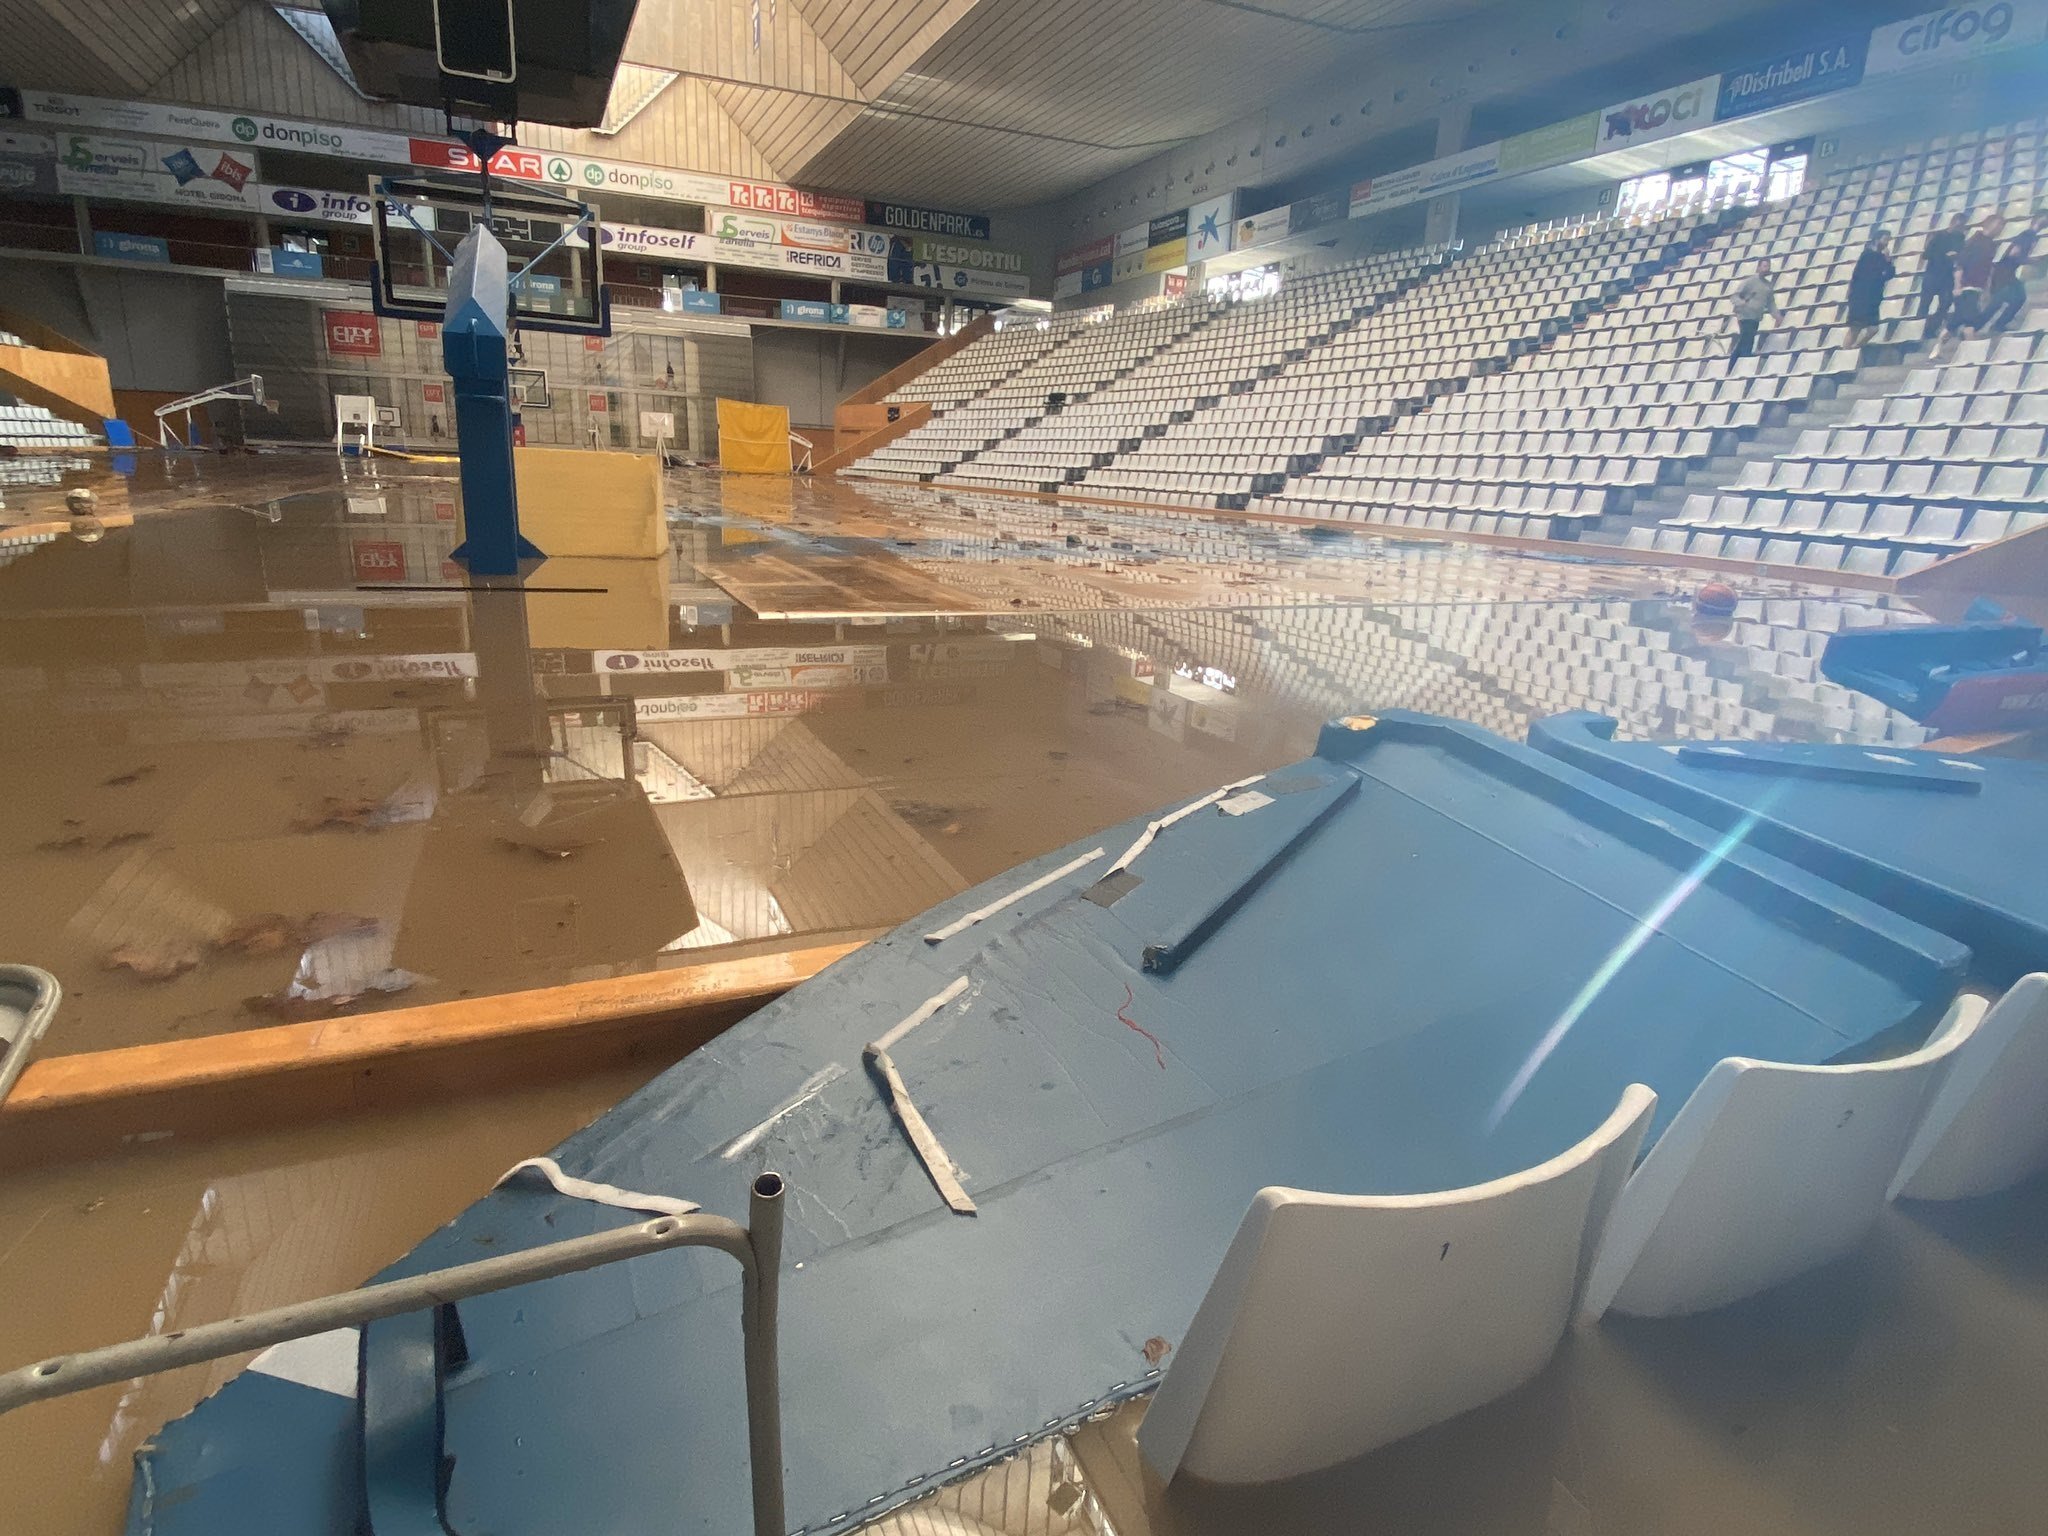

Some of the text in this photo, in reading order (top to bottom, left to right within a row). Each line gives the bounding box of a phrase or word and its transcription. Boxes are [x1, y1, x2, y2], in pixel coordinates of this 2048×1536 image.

[1818, 47, 1850, 77] S.A.
[263, 122, 343, 148] donpiso
[609, 169, 674, 191] donpiso
[321, 210, 368, 221] group
[617, 227, 695, 250] infoself
[794, 223, 823, 238] Estanys
[118, 240, 160, 255] girona
[617, 242, 648, 253] group
[870, 235, 884, 255] hp
[922, 242, 1023, 272] L'ESPORTIU
